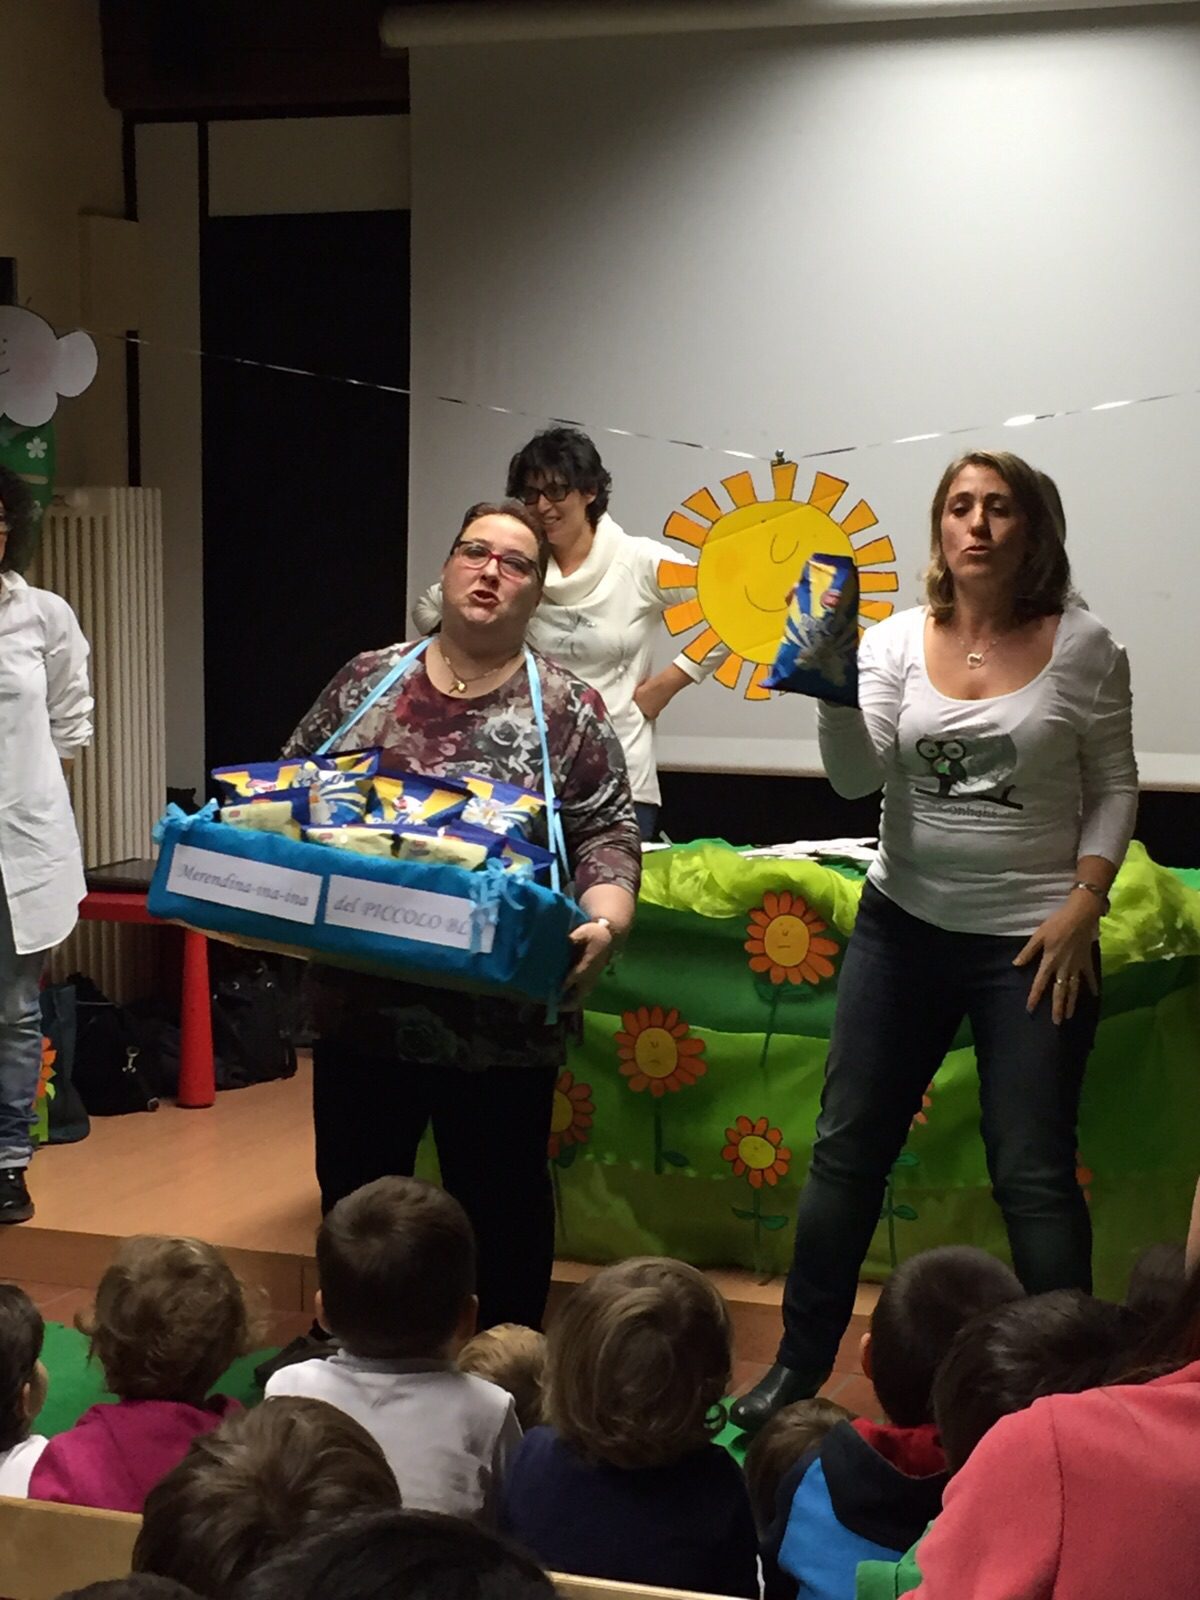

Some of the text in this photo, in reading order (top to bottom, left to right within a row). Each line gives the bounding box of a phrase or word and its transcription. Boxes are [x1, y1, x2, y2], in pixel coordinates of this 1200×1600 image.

[333, 895, 470, 935] del PICCOLO BL
